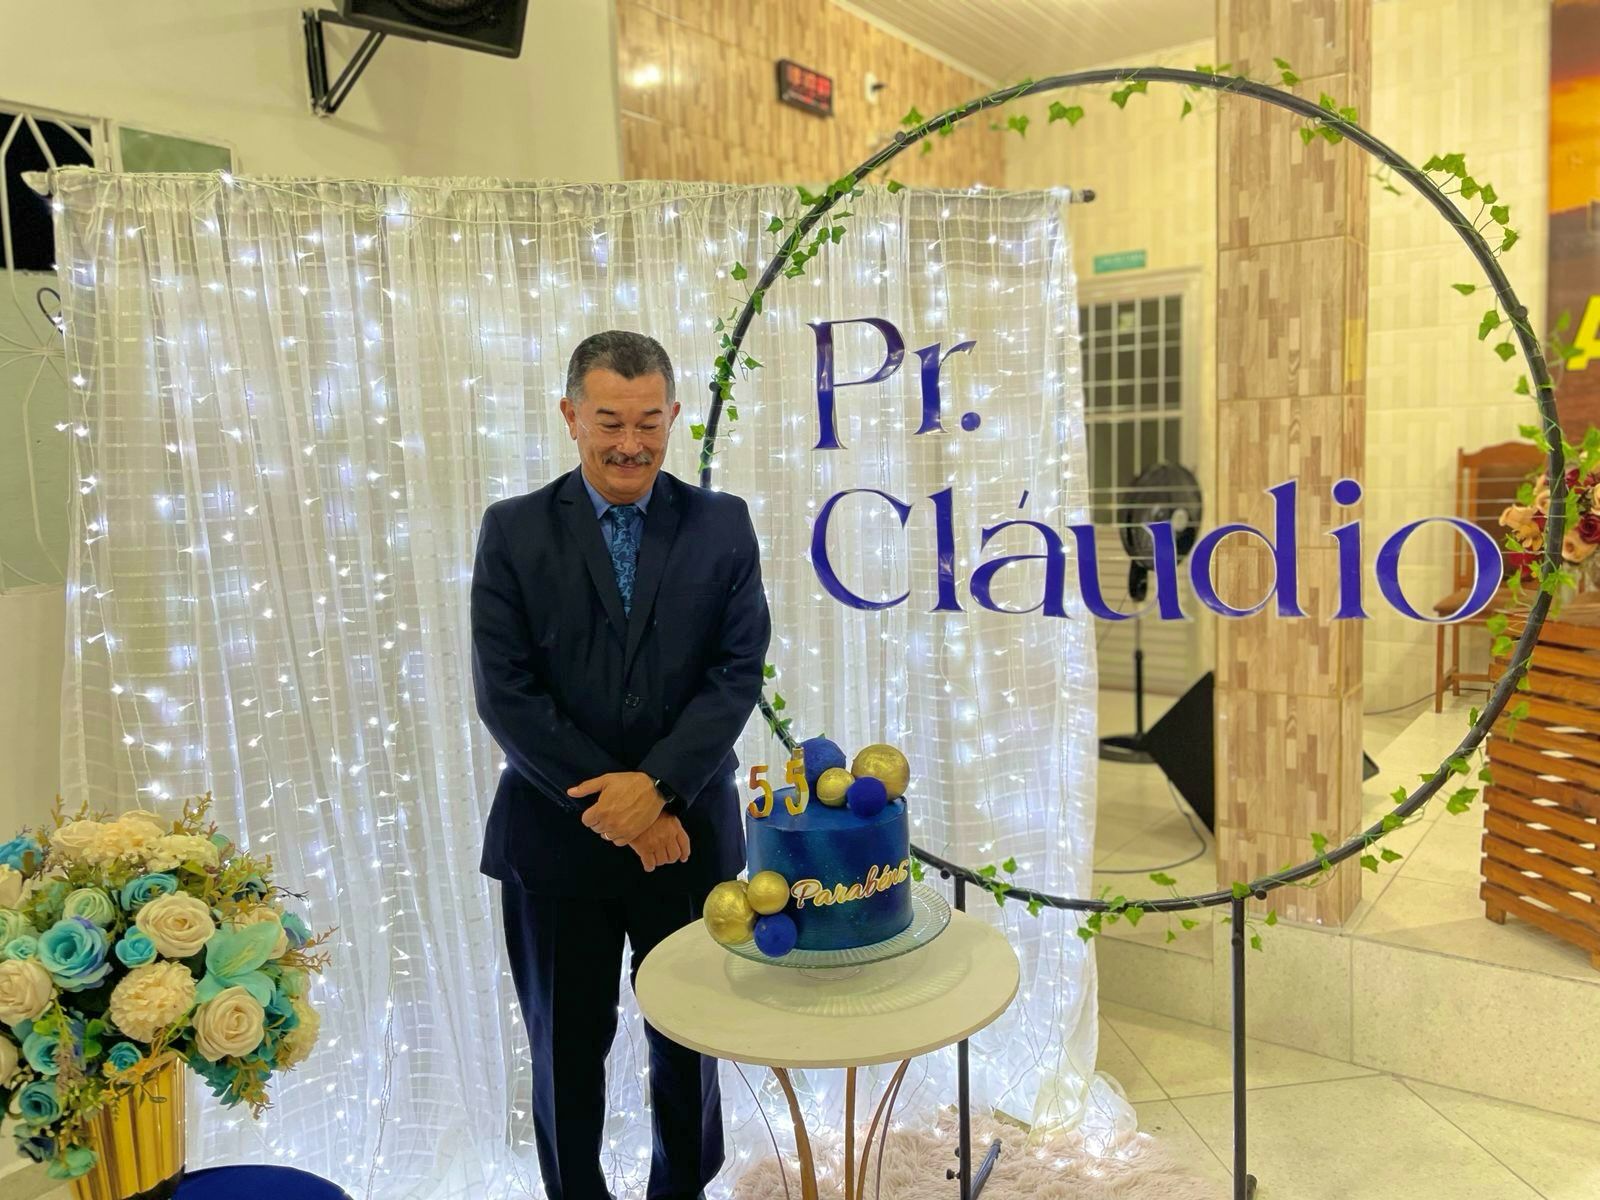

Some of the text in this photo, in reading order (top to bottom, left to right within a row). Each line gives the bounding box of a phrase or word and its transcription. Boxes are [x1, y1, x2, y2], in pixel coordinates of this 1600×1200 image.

[807, 316, 981, 450] Pr.
[810, 477, 1504, 624] Cláudio
[748, 760, 809, 818] 55
[791, 859, 910, 909] Parabéns
